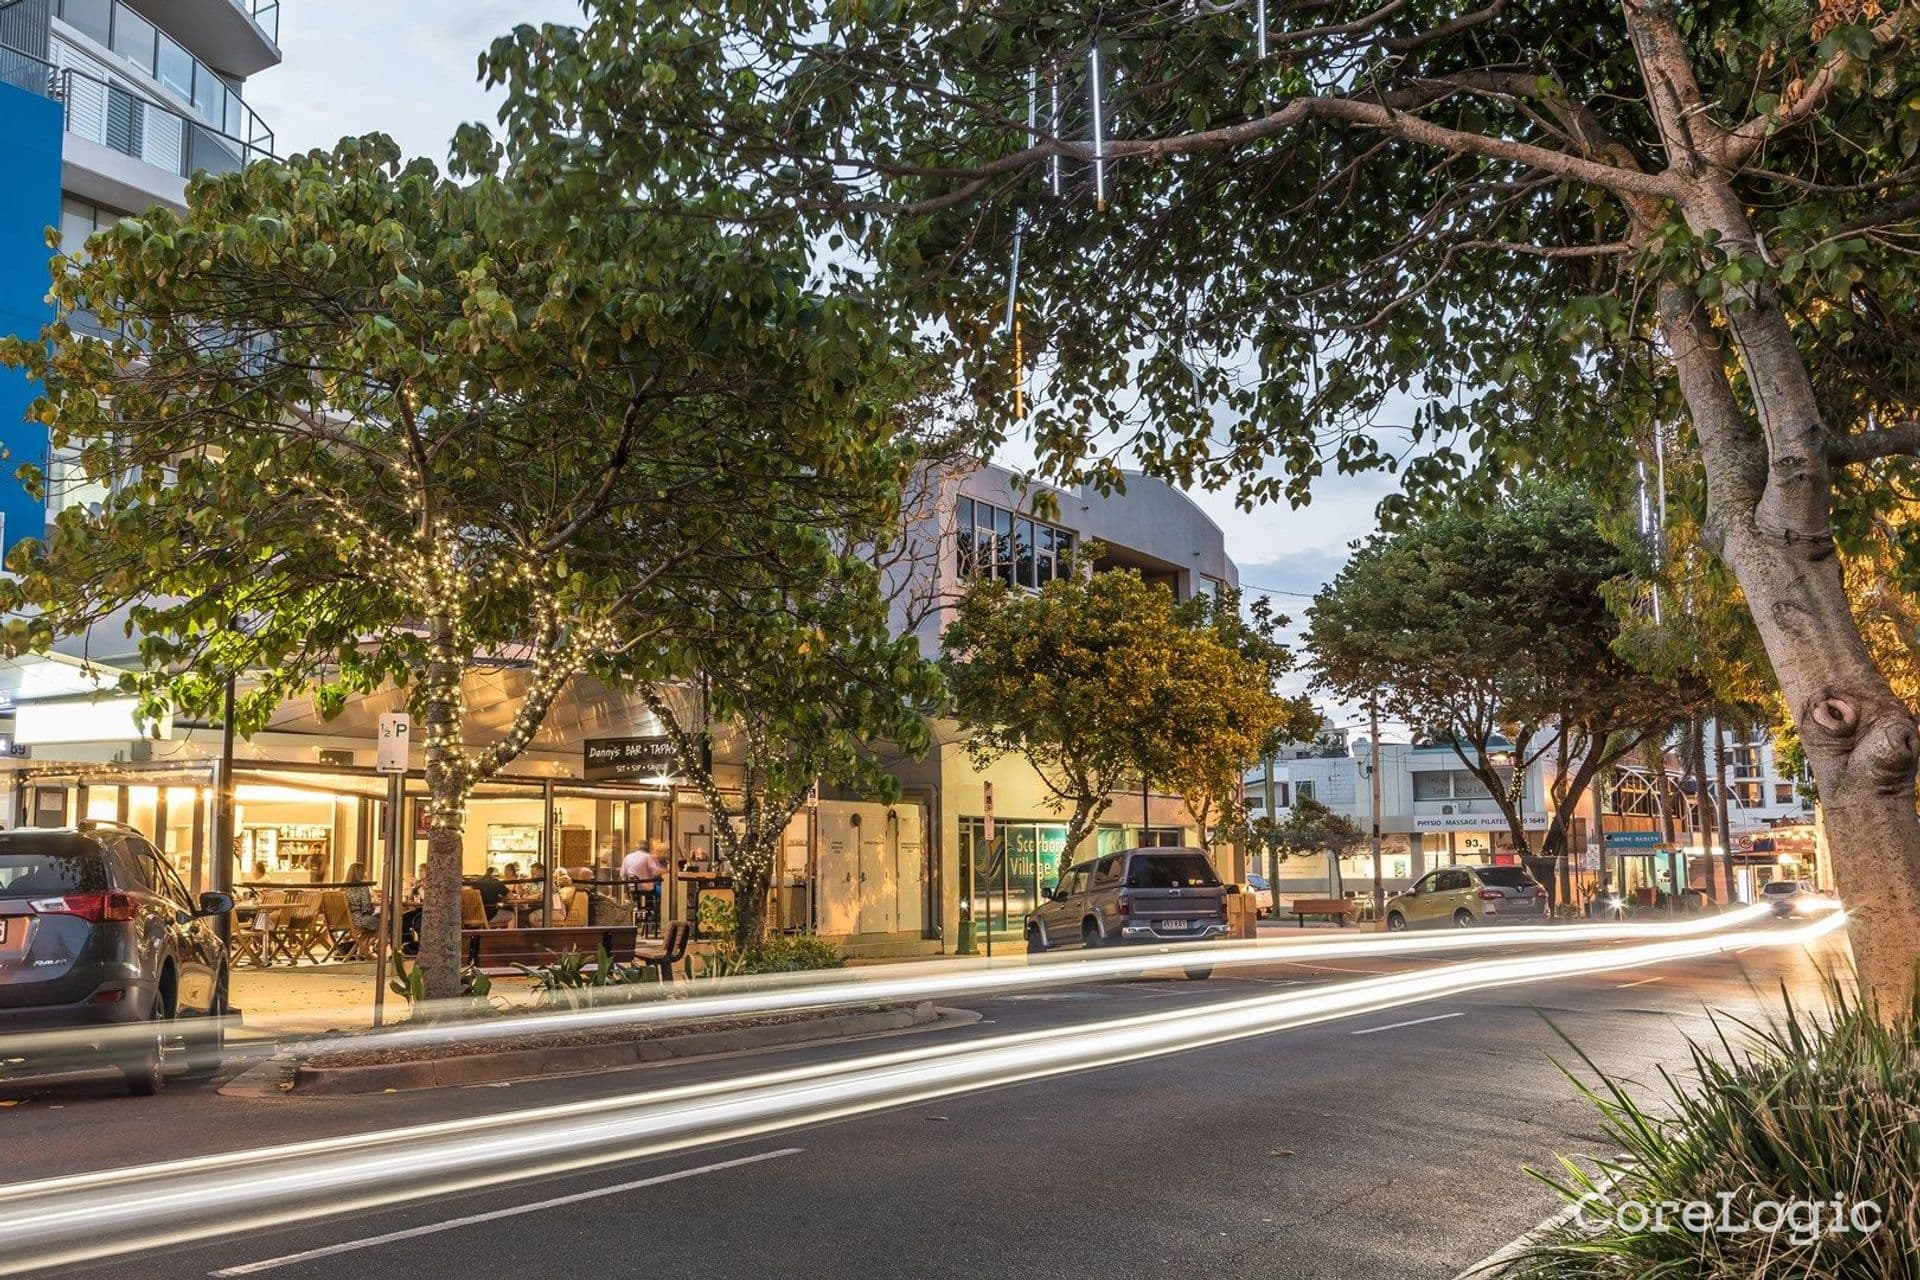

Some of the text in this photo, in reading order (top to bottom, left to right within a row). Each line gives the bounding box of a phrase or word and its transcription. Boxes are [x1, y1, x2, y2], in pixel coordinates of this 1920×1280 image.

[589, 746, 621, 760] Danny's
[625, 744, 642, 756] BAR
[650, 743, 677, 755] TAPAS
